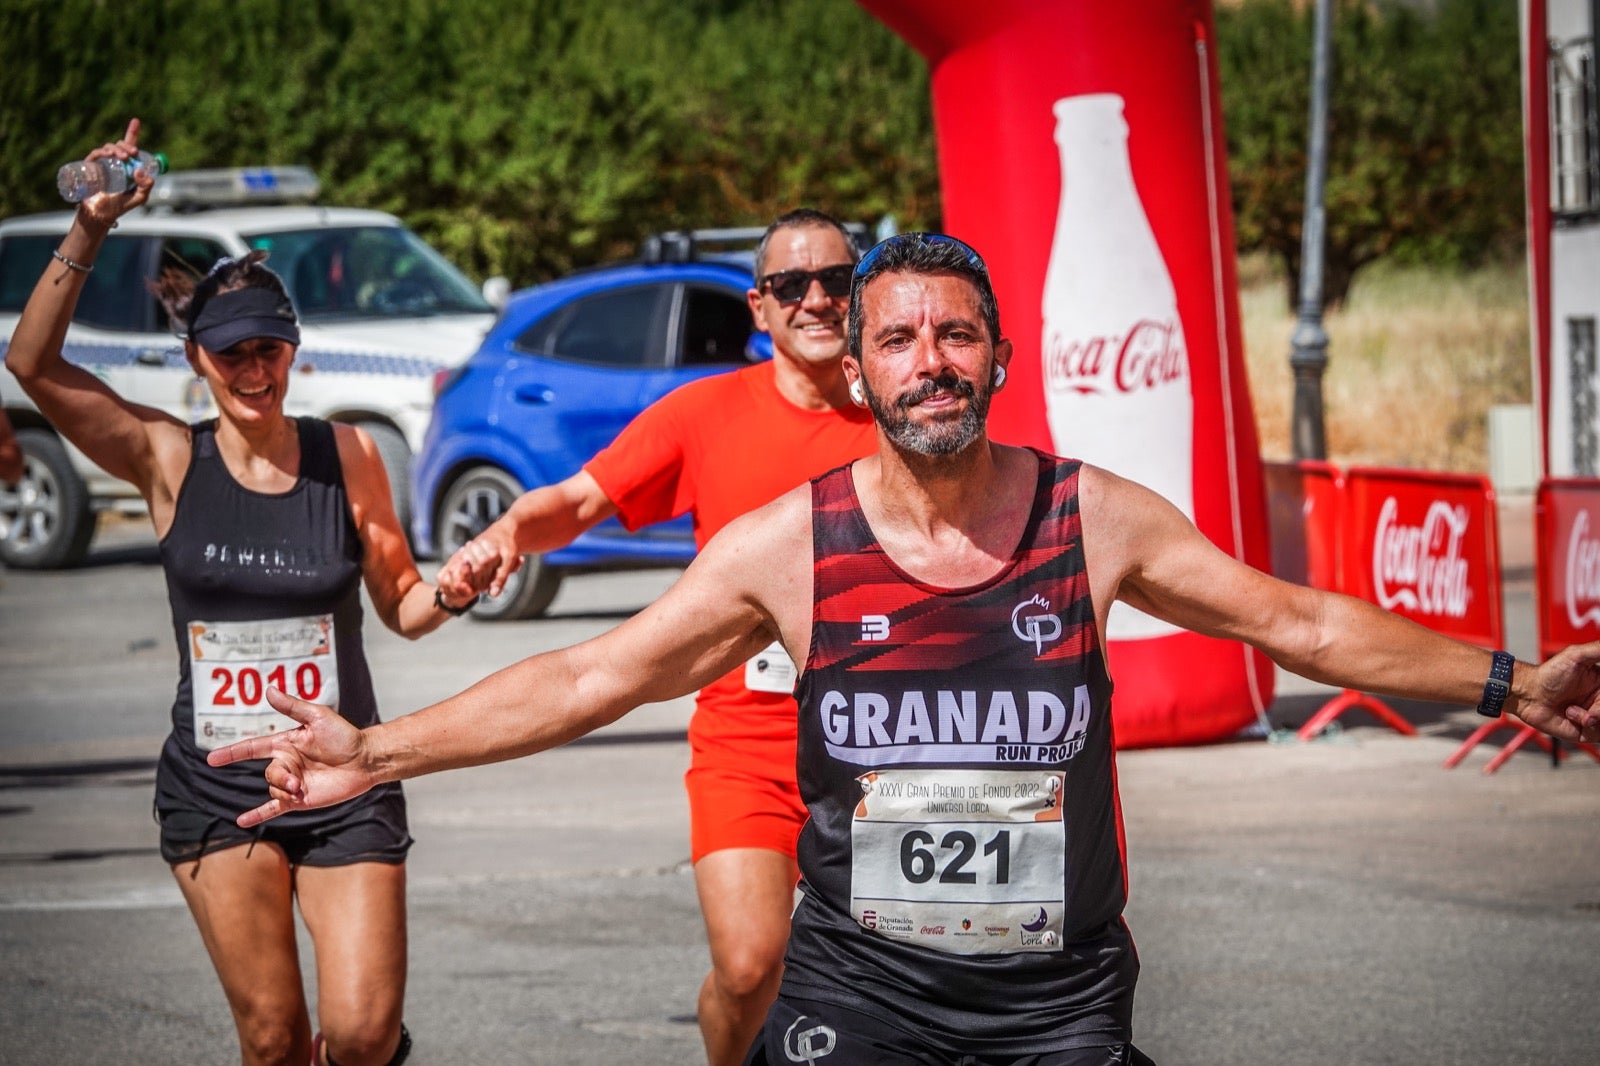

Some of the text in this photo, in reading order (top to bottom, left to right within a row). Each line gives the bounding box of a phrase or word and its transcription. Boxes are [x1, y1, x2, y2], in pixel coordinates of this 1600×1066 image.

[211, 662, 322, 706] 2010
[819, 684, 1091, 747] GRANADA
[995, 745, 1031, 761] RUN
[879, 782, 904, 798] XXXV
[1014, 783, 1040, 799] 2022
[900, 829, 1011, 885] 621
[879, 915, 914, 925] Diputación
[886, 924, 914, 932] Granada
